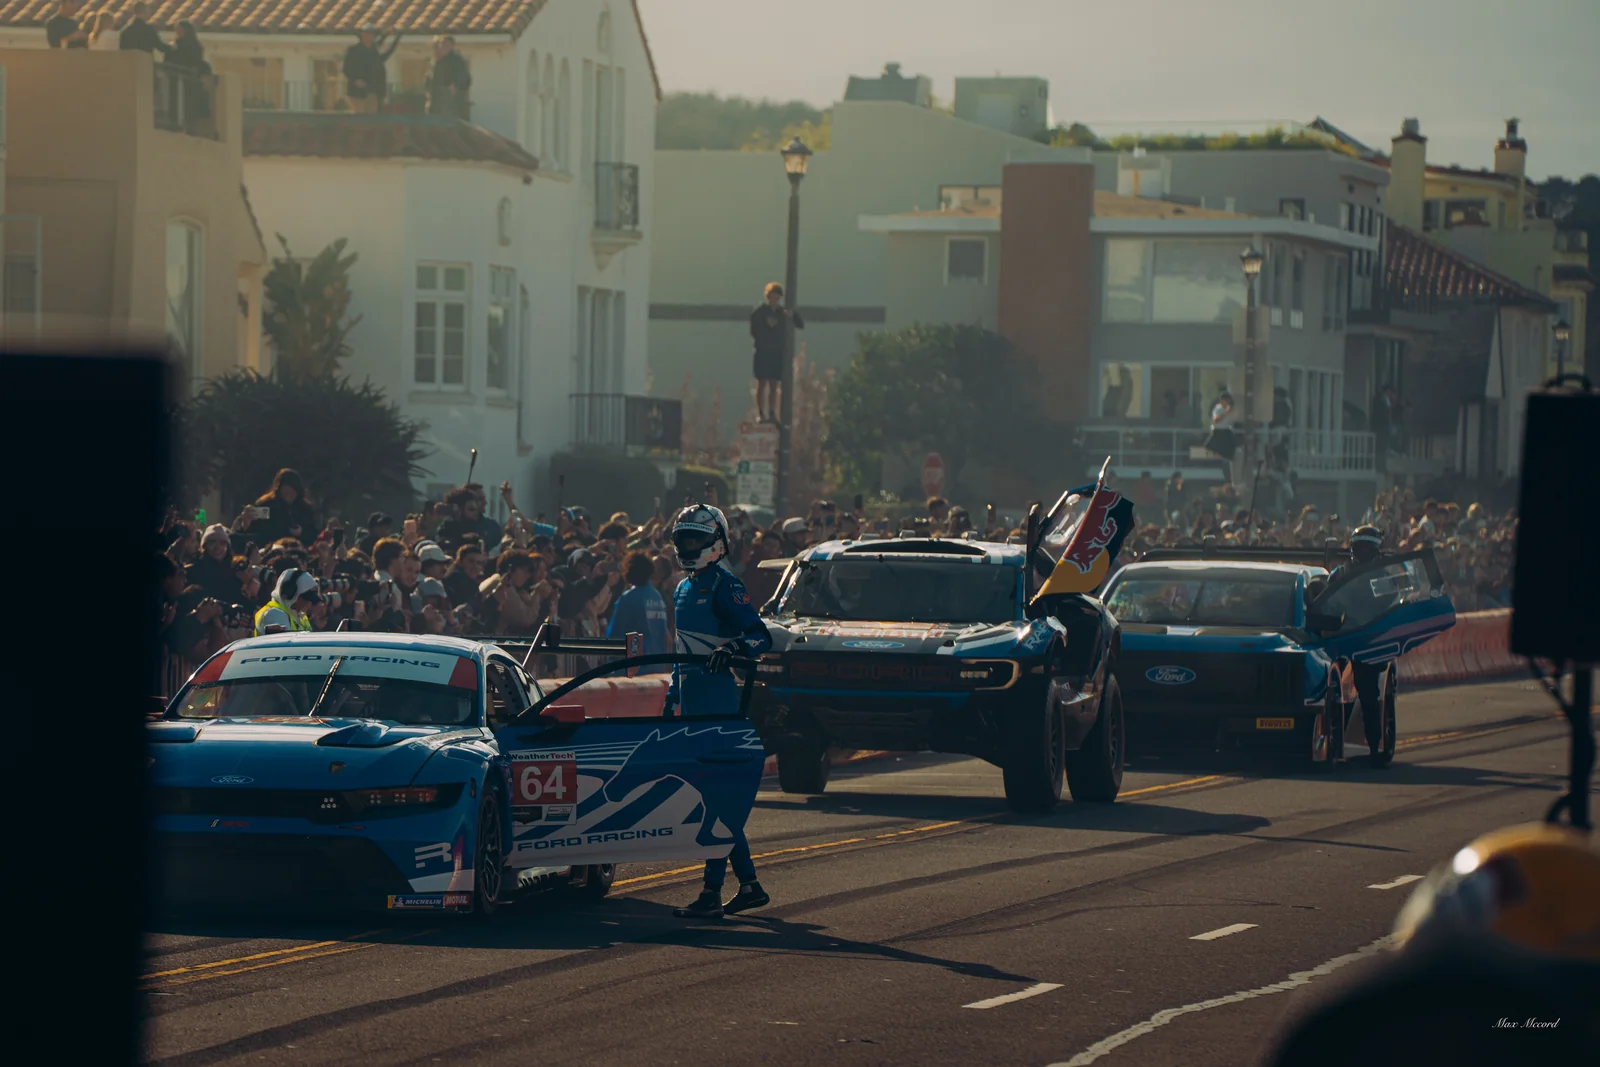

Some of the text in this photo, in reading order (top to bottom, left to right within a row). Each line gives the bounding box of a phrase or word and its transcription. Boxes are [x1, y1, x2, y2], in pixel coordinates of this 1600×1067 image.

[240, 655, 440, 669] FORD RACING
[1155, 668, 1187, 681] Ford
[1260, 719, 1291, 728] PIRELLI
[511, 753, 574, 761] WeatherTech
[520, 764, 567, 801] 64
[517, 827, 674, 852] FORD RACING
